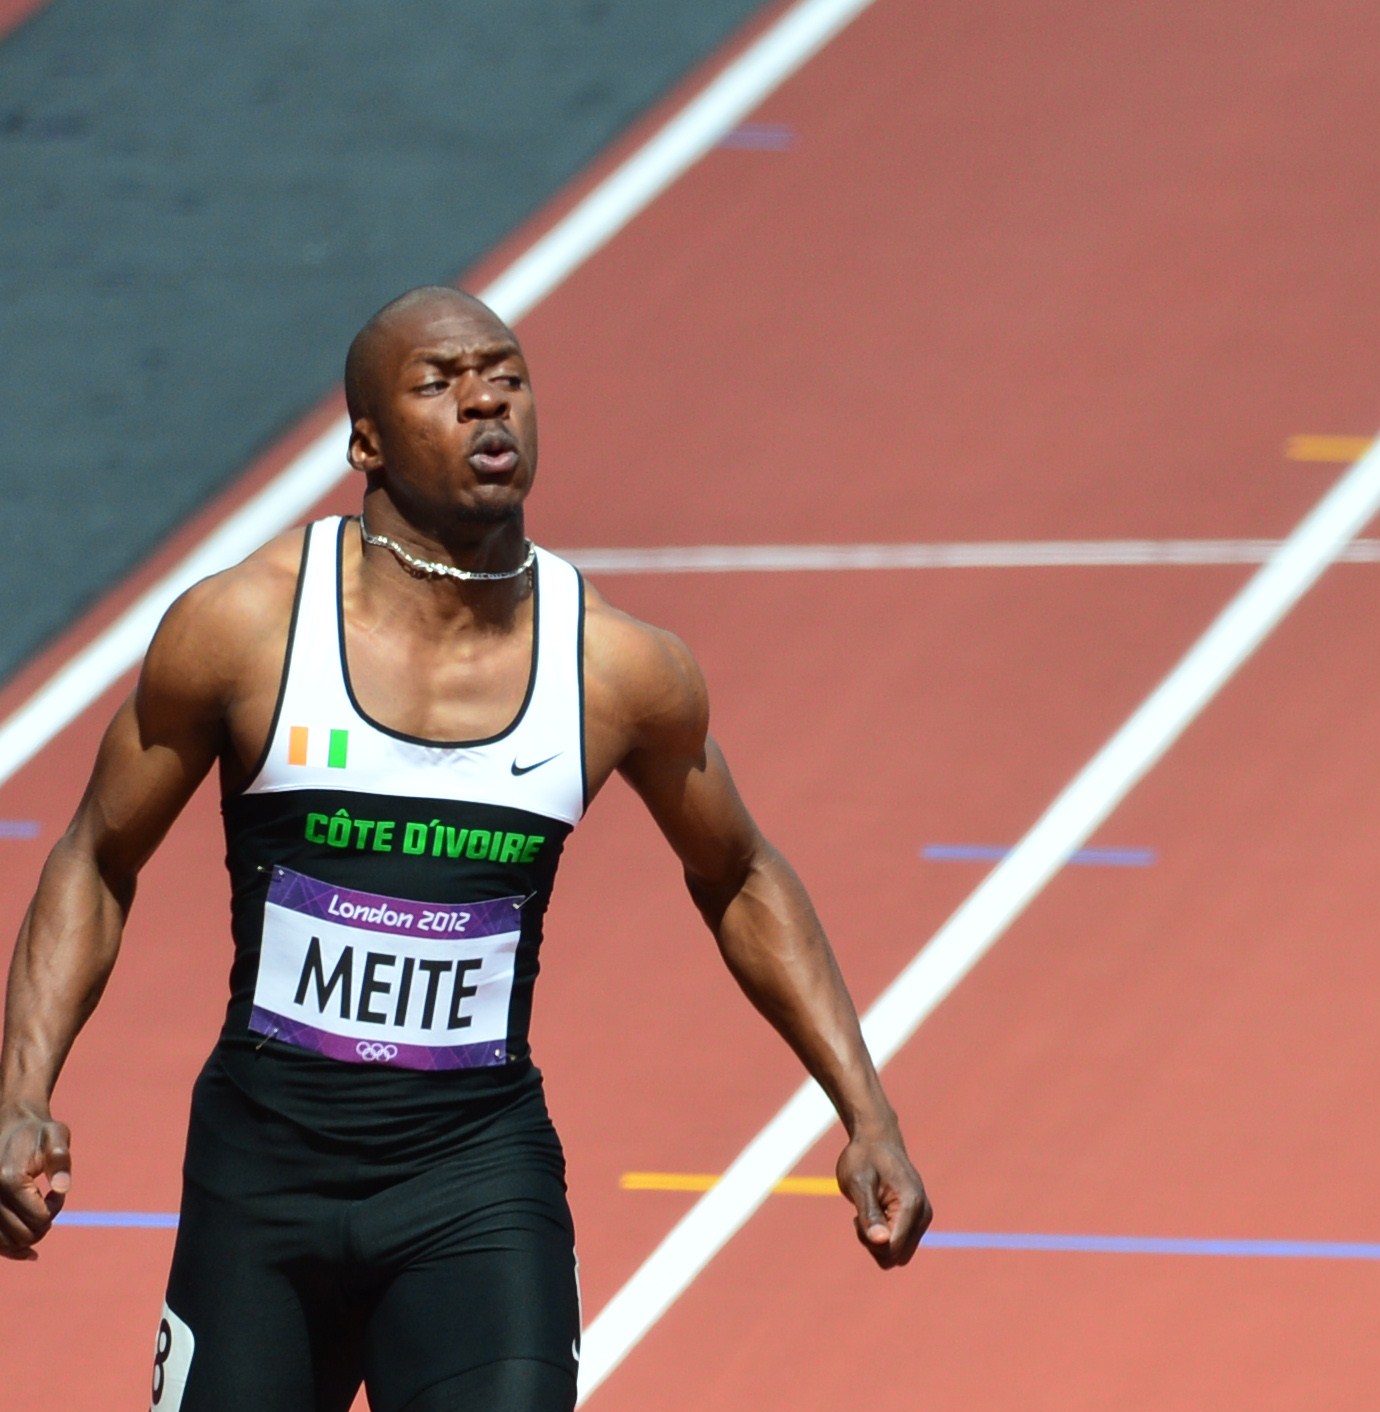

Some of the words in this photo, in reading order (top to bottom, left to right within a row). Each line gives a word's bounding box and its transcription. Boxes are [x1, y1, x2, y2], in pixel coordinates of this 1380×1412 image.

[305, 808, 395, 853] CÔTE
[327, 894, 415, 929] London
[417, 909, 472, 933] 2012
[293, 936, 484, 1031] MEITE
